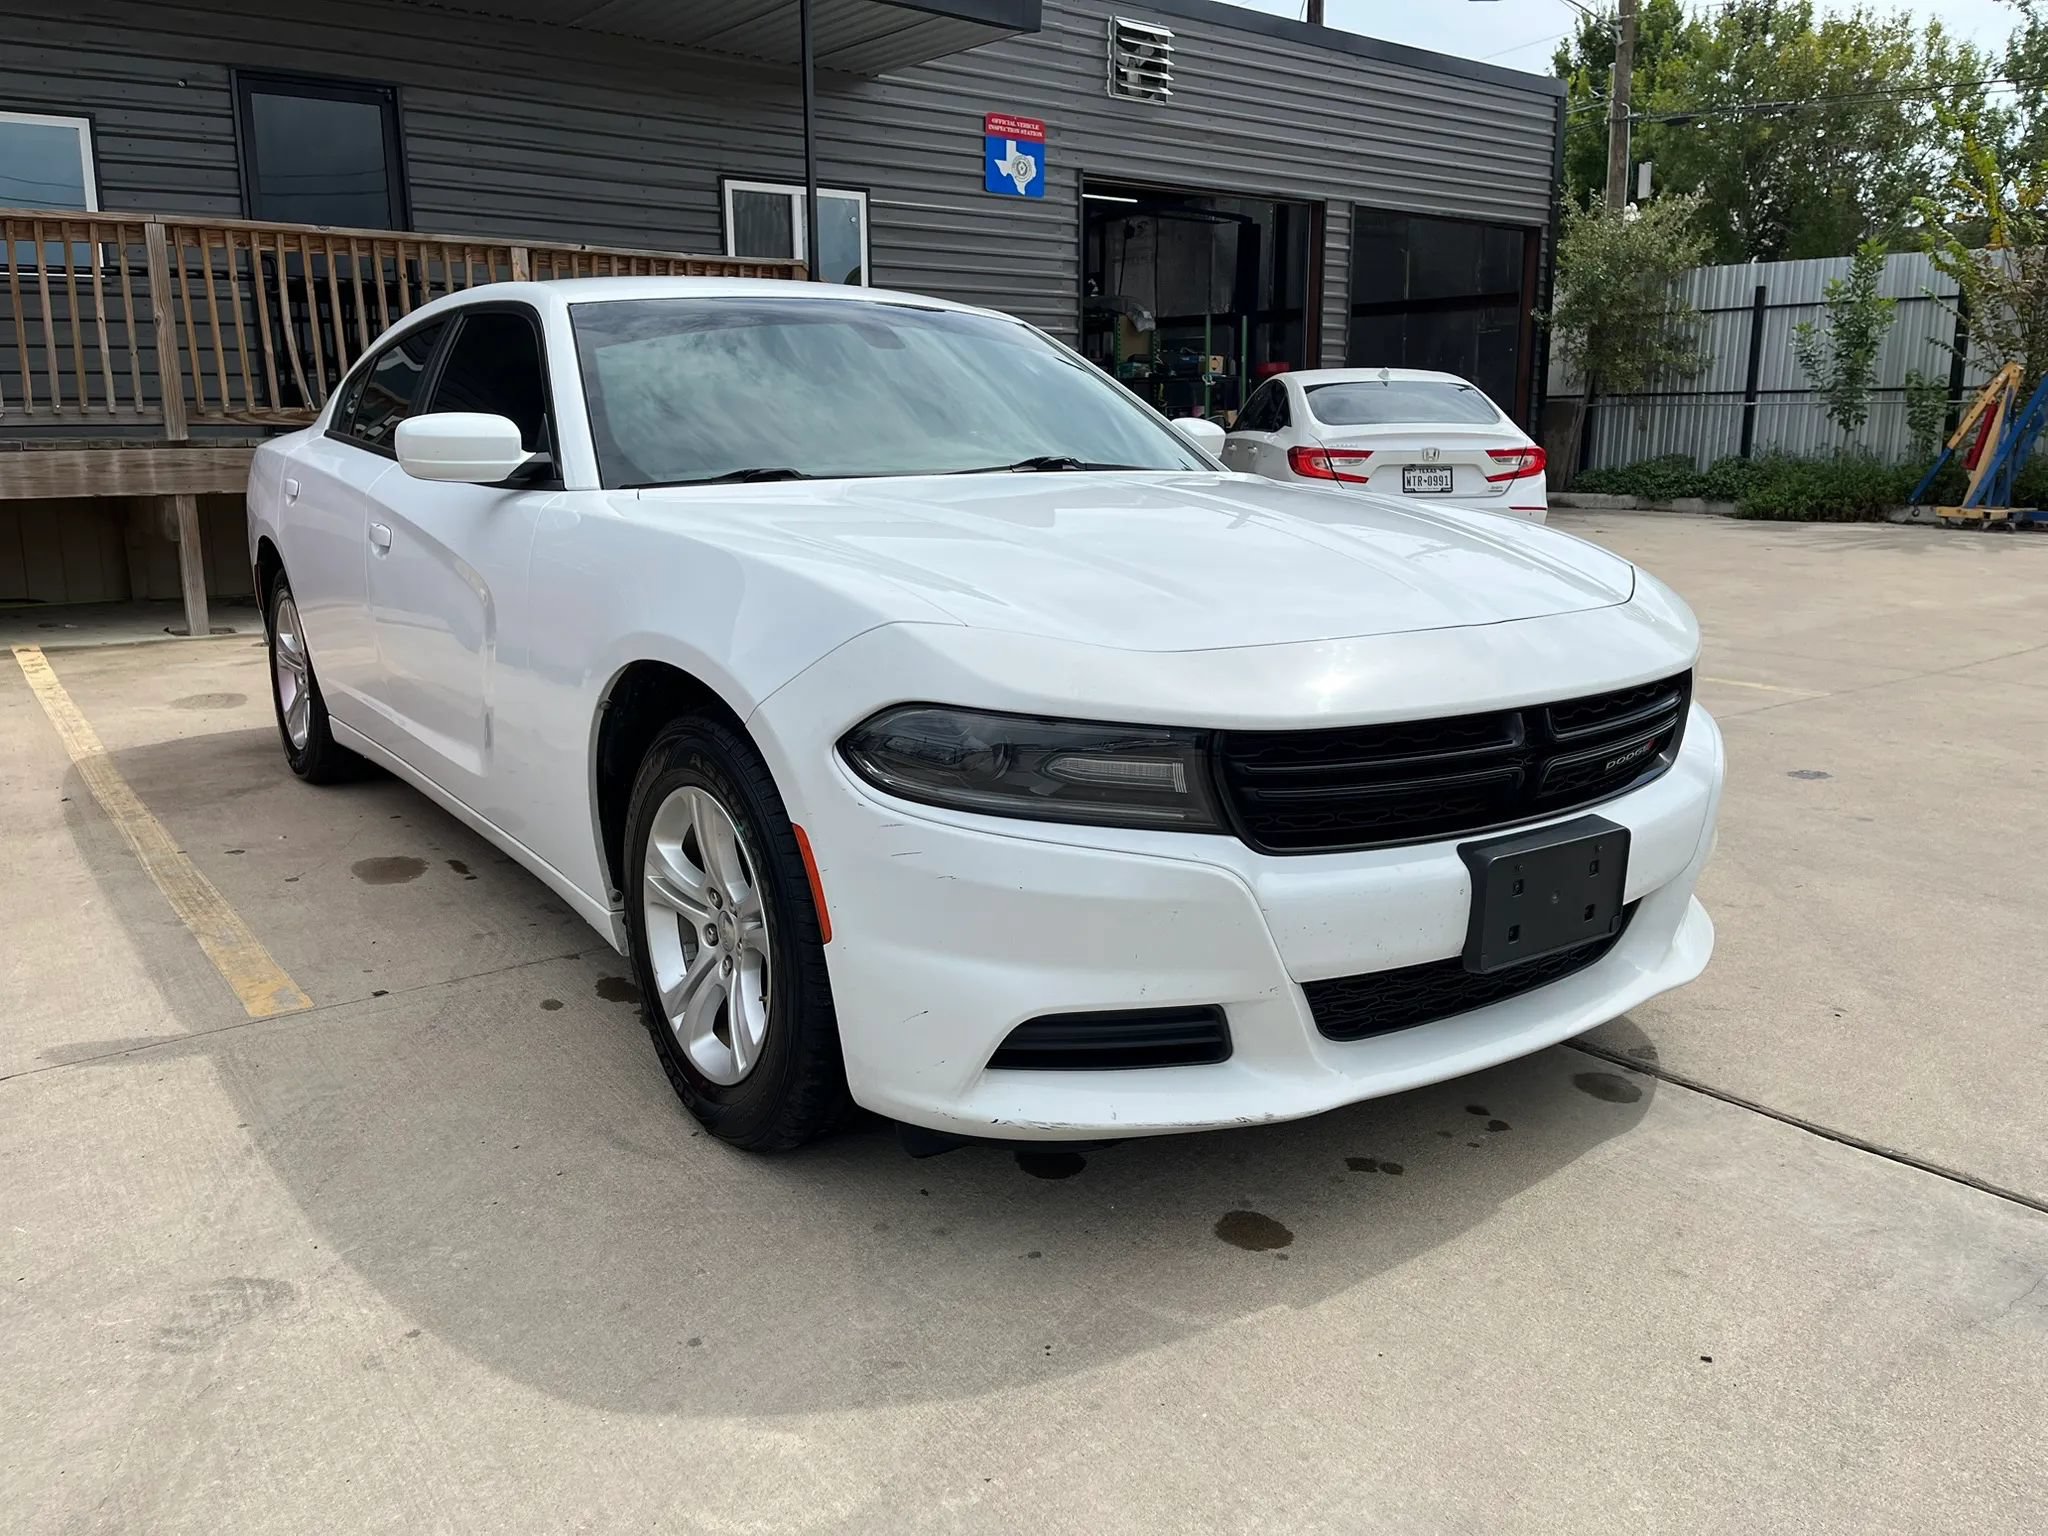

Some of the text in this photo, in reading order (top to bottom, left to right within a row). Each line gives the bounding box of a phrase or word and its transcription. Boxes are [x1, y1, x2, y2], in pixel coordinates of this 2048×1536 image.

[991, 117, 1040, 130] OFFICIAL VEHICLE
[988, 124, 1043, 137] INSPECTION STATION
[1605, 744, 1650, 770] DODGE
